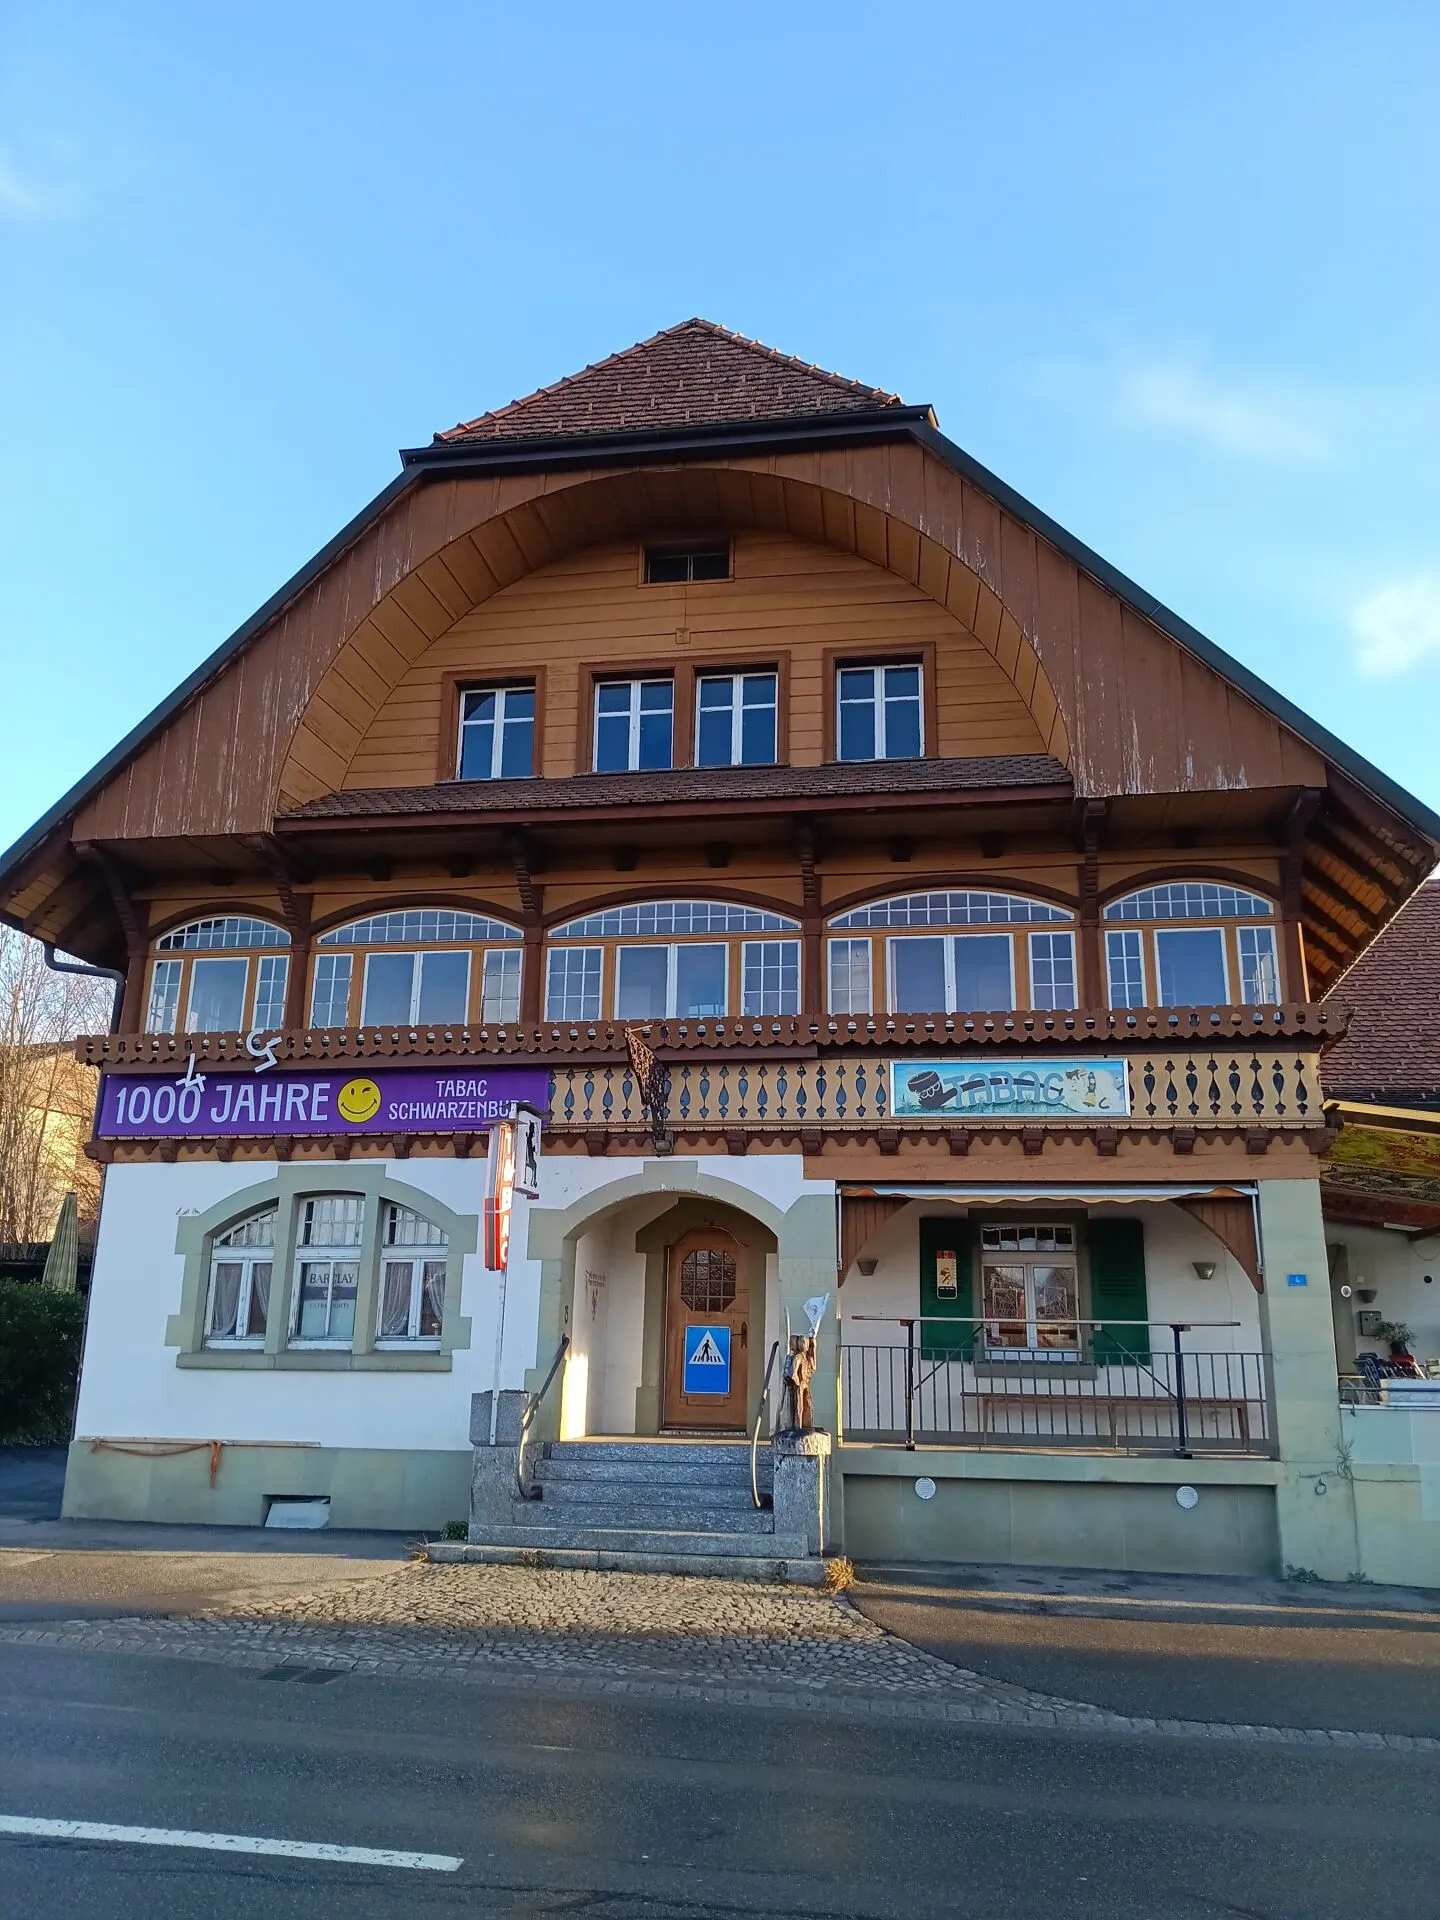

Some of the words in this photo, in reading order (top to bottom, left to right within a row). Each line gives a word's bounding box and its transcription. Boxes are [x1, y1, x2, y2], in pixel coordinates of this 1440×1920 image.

[115, 1085, 201, 1125] 1000
[210, 1082, 330, 1123] JAHRE
[436, 1080, 488, 1098] TABAC
[943, 1070, 1065, 1108] TABAC
[388, 1100, 530, 1121] SCHWARZENBU
